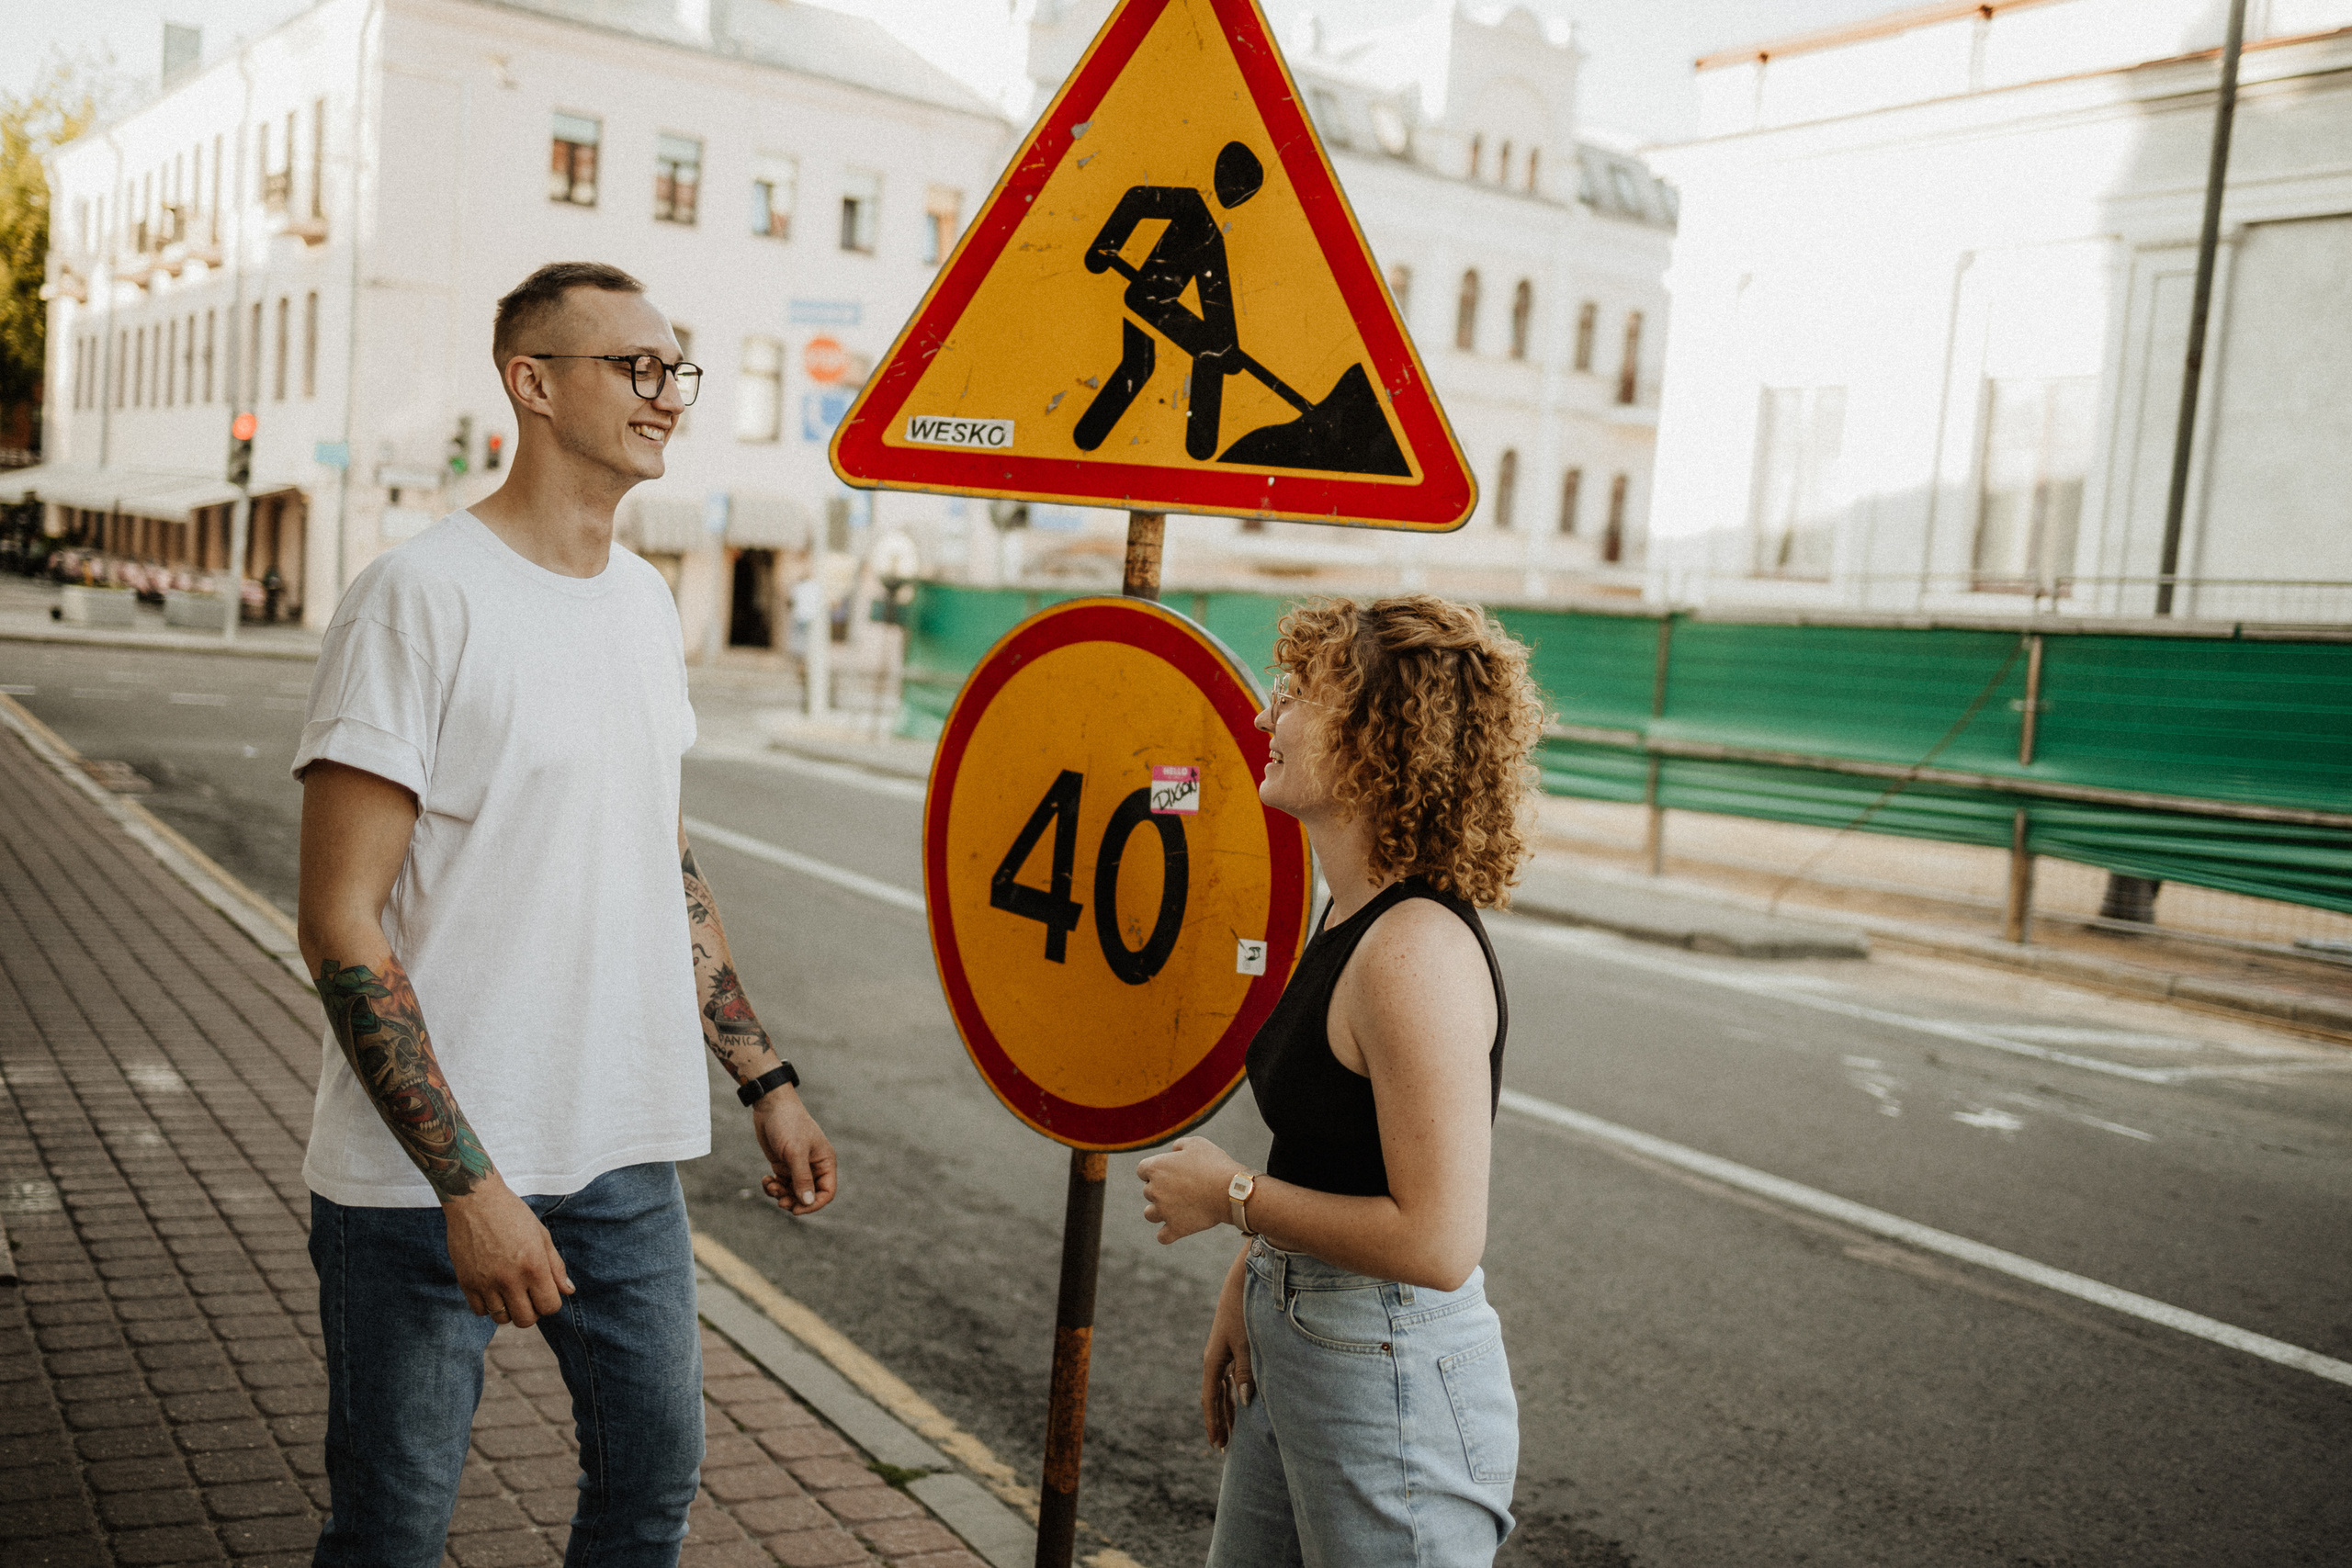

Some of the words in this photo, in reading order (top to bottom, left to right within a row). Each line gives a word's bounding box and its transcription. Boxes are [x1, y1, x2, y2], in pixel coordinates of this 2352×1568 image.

[911, 420, 1006, 446] WESKO
[1162, 766, 1188, 776] HELLO
[989, 769, 1190, 986] 40
[718, 1033, 753, 1047] PANIC
